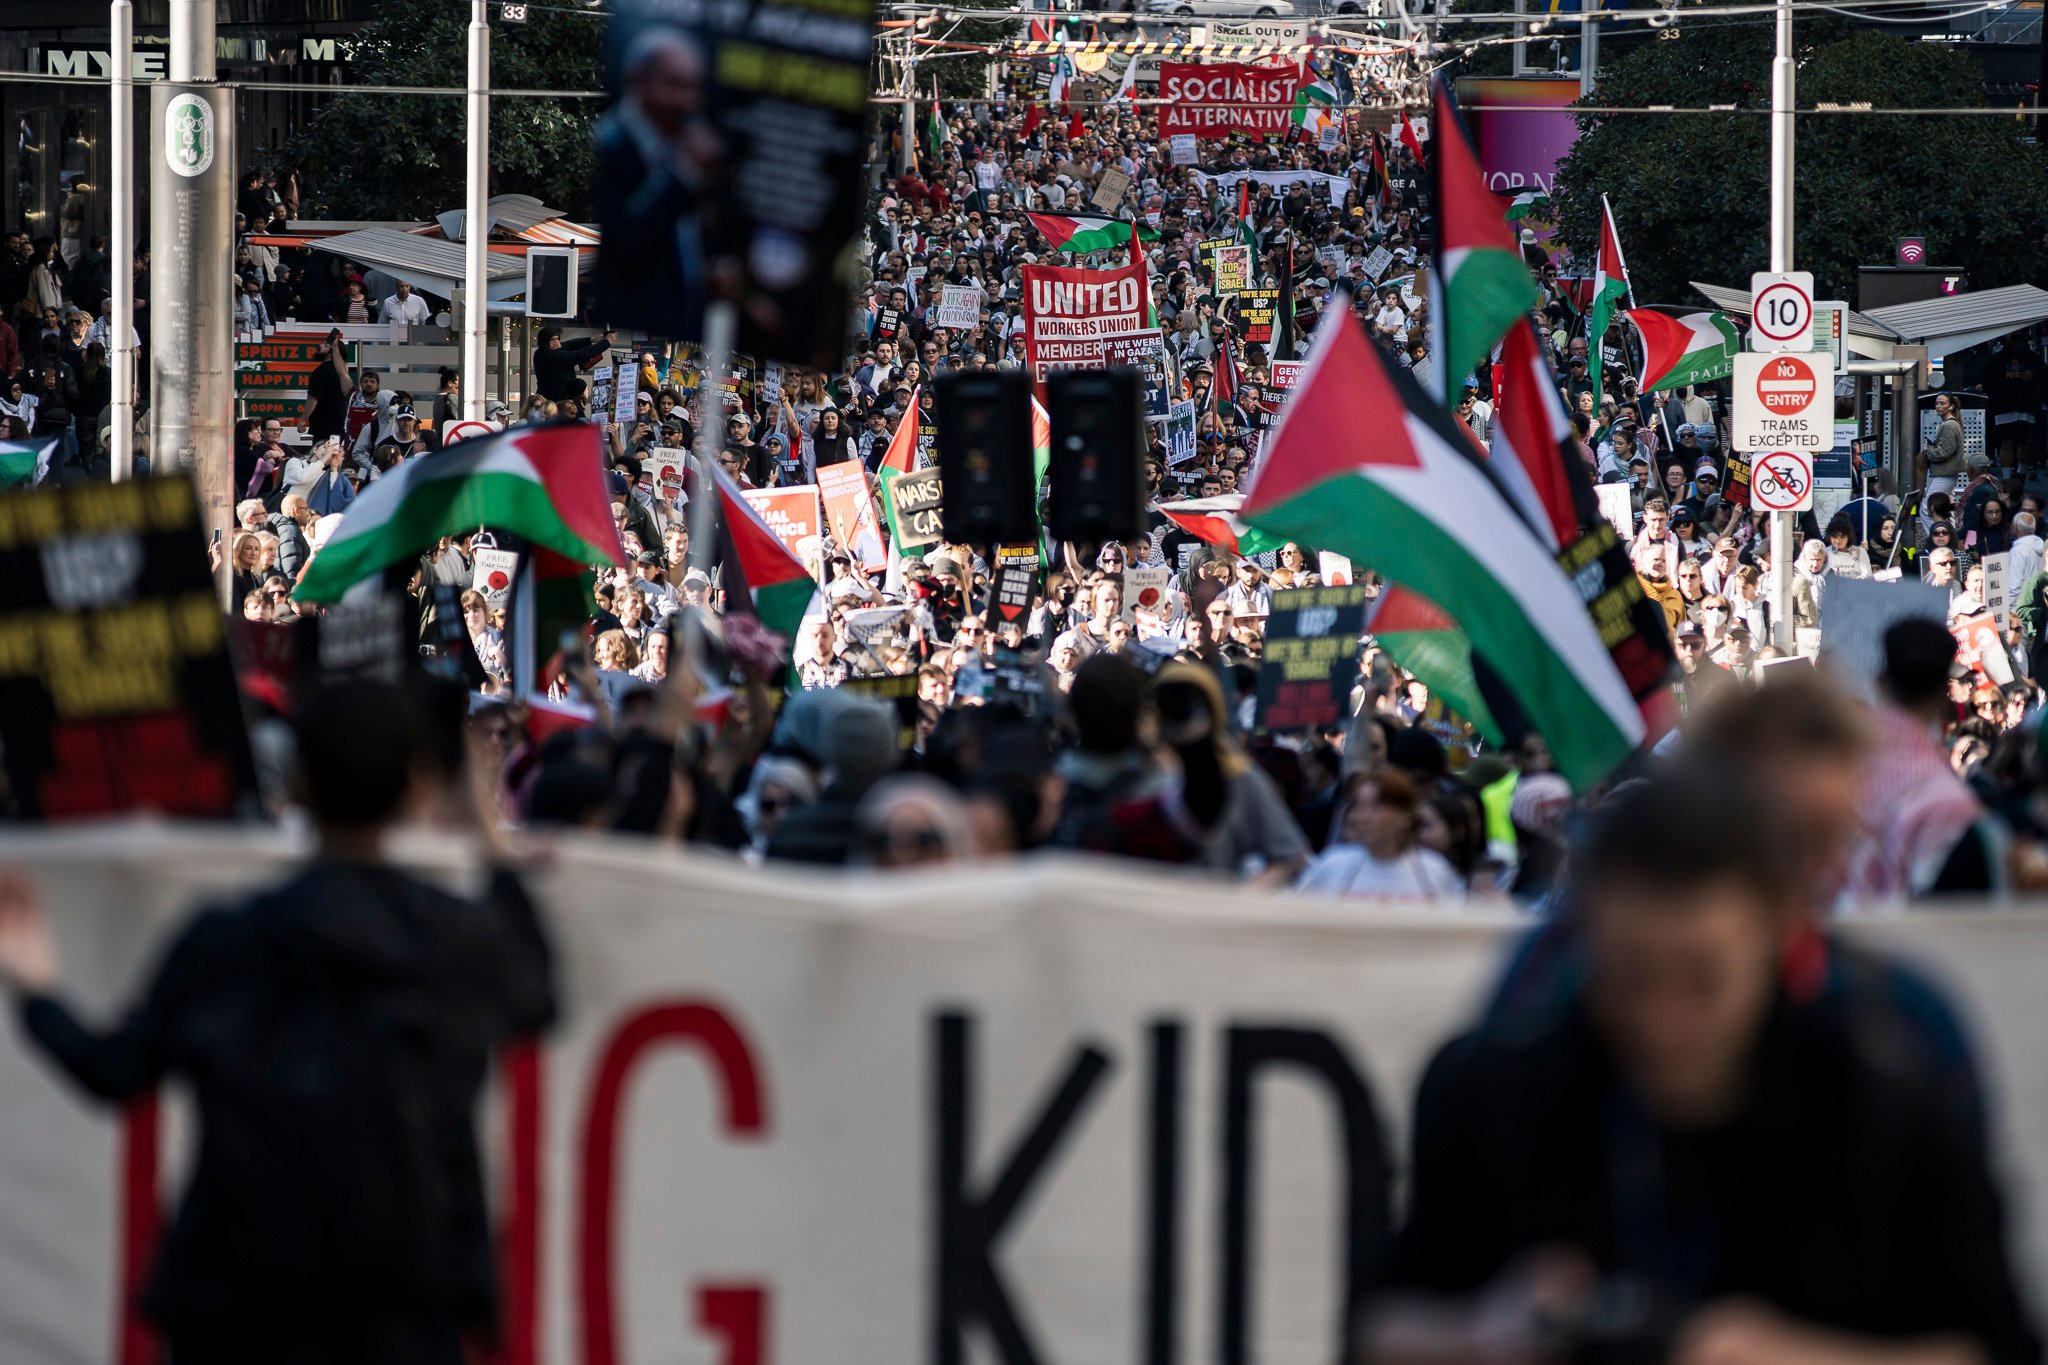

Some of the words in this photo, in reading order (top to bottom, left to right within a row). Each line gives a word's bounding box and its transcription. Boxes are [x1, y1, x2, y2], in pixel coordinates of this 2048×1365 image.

[504, 6, 525, 20] 33
[1213, 25, 1252, 35] ISRAEL
[1256, 28, 1280, 36] OUT
[1660, 28, 1680, 40] 33
[1136, 60, 1161, 70] RIKE
[1168, 76, 1298, 103] SOCIALIST
[1200, 242, 1216, 250] YOU'RE
[1216, 240, 1226, 248] SICK
[1364, 251, 1380, 271] FREE
[1219, 262, 1239, 272] STOP
[1218, 278, 1245, 290] ISRAEL
[1032, 276, 1139, 315] UNITED
[1272, 290, 1280, 298] OF
[1253, 298, 1268, 308] US?
[884, 310, 898, 318] DEATH
[1769, 298, 1798, 326] 10
[1038, 320, 1097, 336] WORKERS
[1099, 317, 1136, 333] UNION
[1104, 342, 1112, 350] IF
[1114, 340, 1130, 349] WE
[1132, 337, 1161, 347] WERE
[239, 346, 299, 358] SPRITZ
[1114, 350, 1125, 358] IN
[1127, 347, 1153, 357] GAZA
[1127, 357, 1139, 365] AS
[1777, 365, 1796, 378] NO
[242, 374, 293, 385] HAPPY
[1276, 376, 1286, 384] IS
[1262, 392, 1287, 403] THERE'S
[1766, 394, 1808, 406] ENTRY
[1260, 413, 1270, 425] IN
[1270, 414, 1284, 426] GA
[1761, 420, 1808, 431] TRAMS
[1750, 435, 1819, 446] EXCEPTED
[913, 508, 944, 534] GA
[1006, 556, 1020, 564] JUST
[1020, 555, 1039, 564] MOVED
[1988, 562, 2002, 573] ISRAEL
[1990, 581, 2000, 590] WILL
[1989, 596, 2002, 607] NEVER
